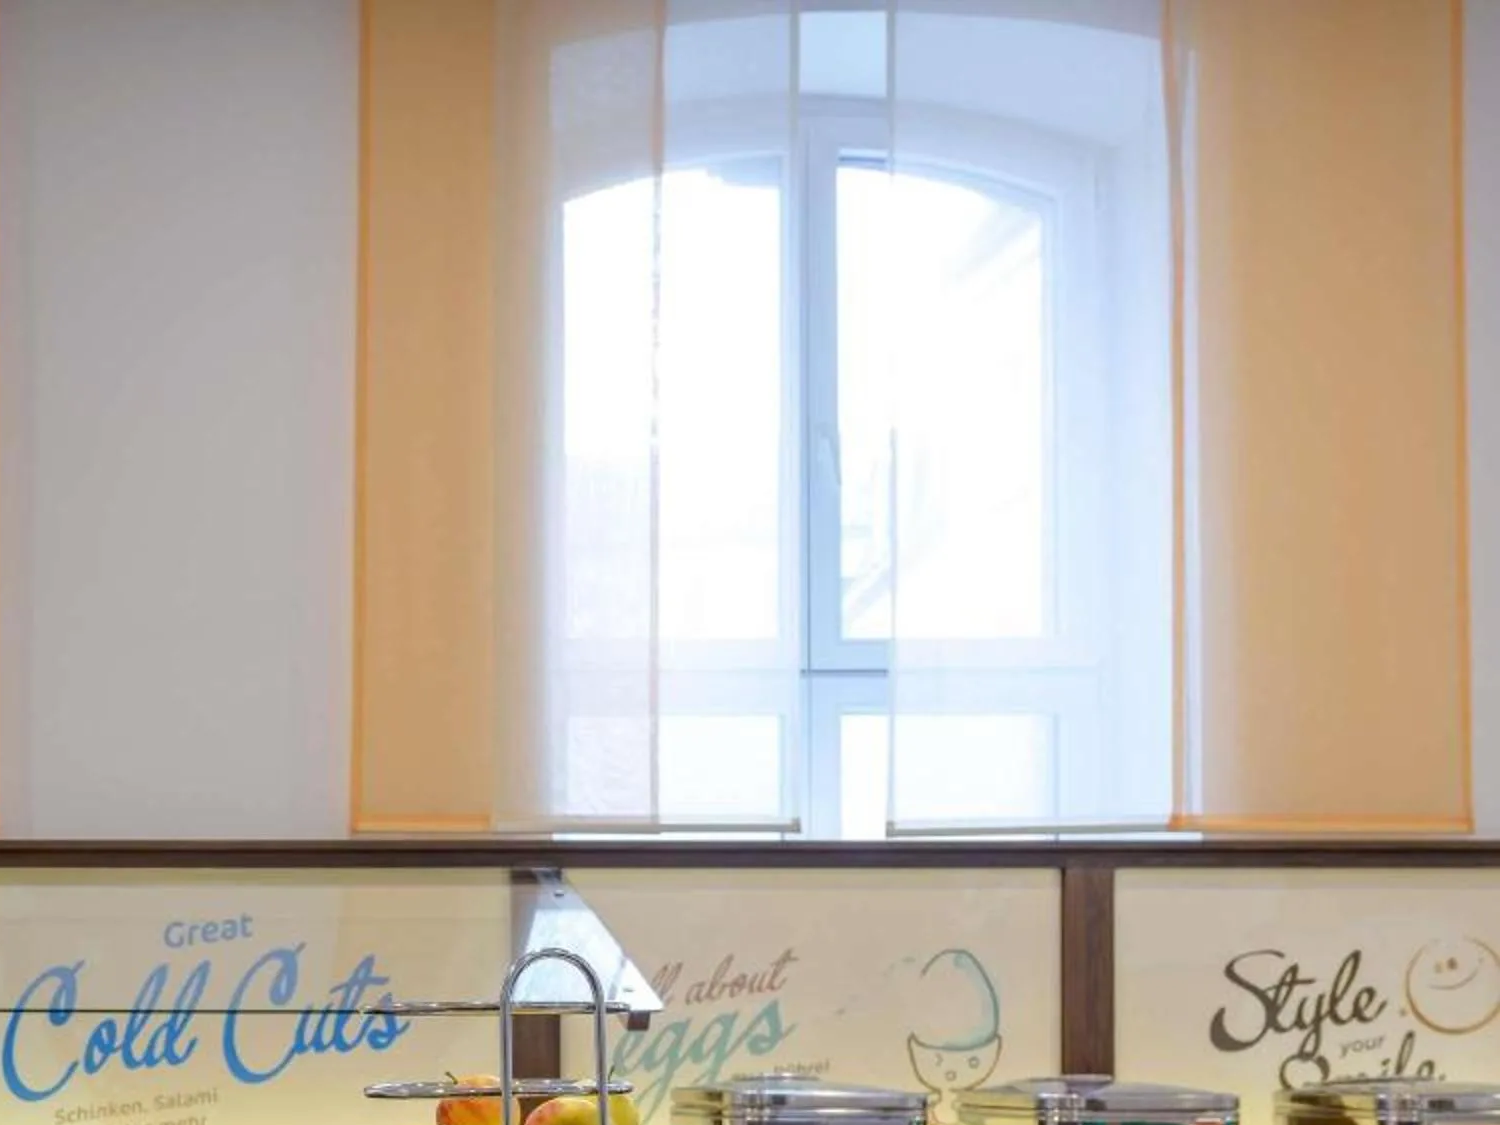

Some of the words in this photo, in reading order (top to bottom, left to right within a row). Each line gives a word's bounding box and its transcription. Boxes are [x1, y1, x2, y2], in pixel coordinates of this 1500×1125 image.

[163, 913, 253, 948] Great
[684, 947, 800, 1006] about
[1, 959, 212, 1102] Cold
[221, 942, 410, 1085] Cuts
[1209, 948, 1388, 1058] Style
[1338, 1034, 1386, 1058] your
[153, 1088, 219, 1112] Salami
